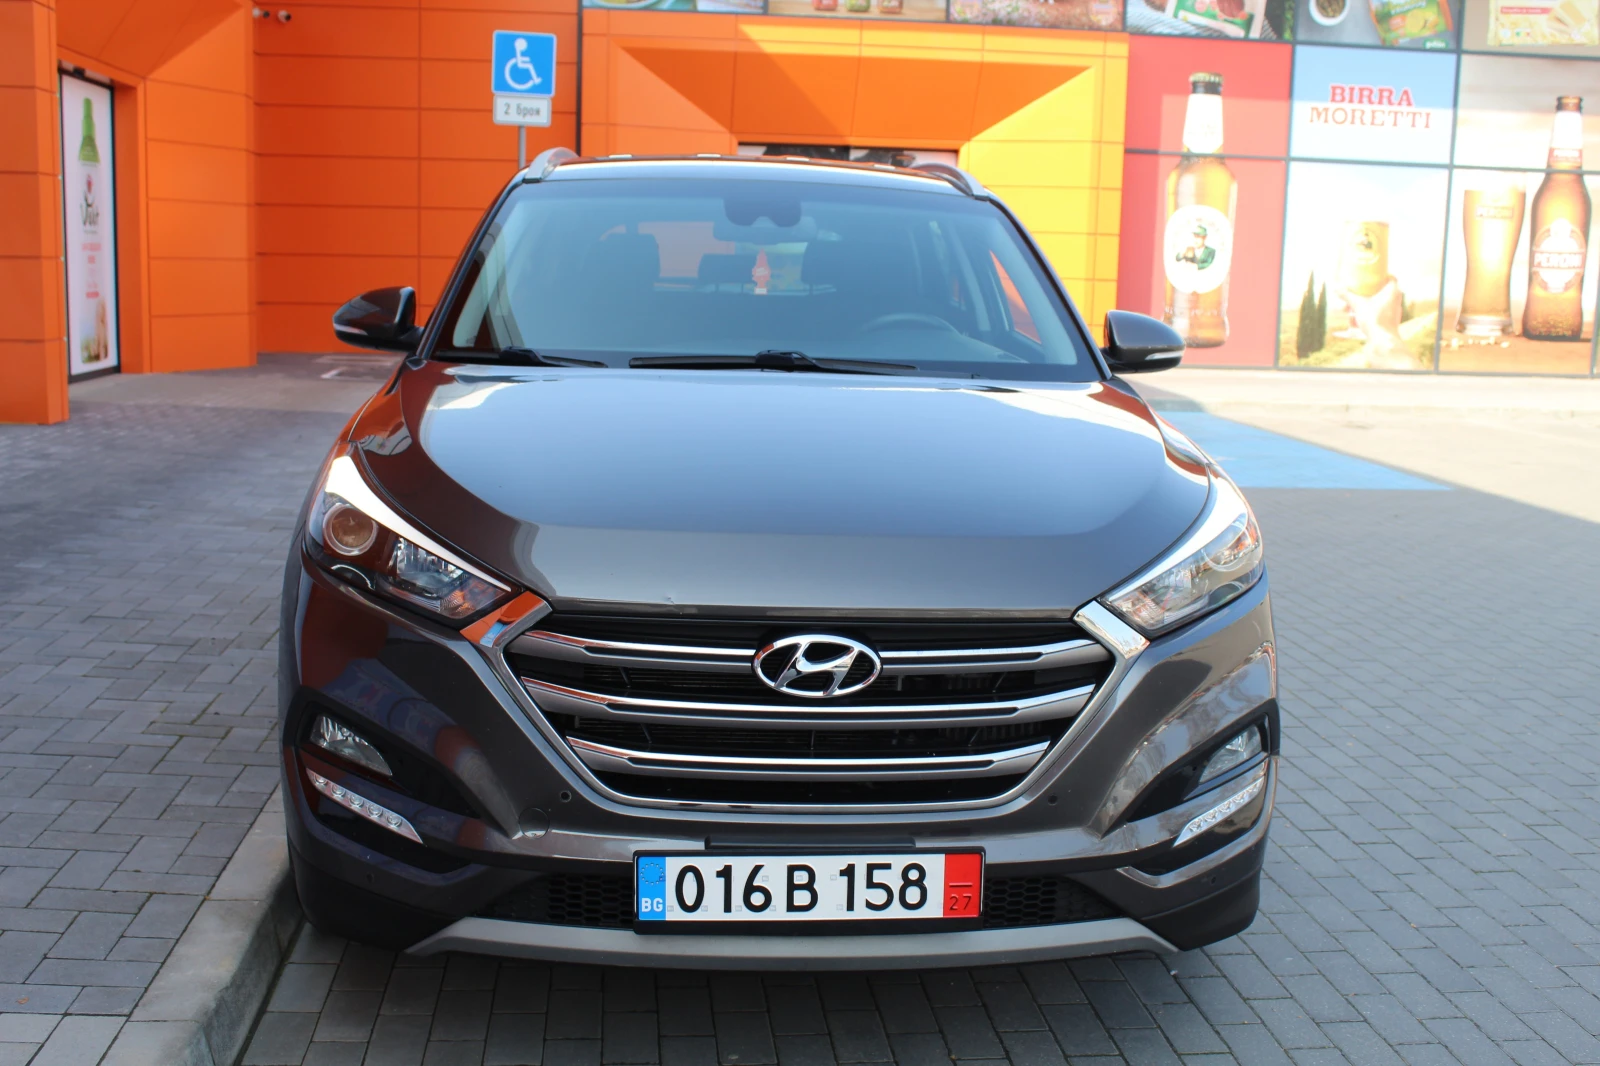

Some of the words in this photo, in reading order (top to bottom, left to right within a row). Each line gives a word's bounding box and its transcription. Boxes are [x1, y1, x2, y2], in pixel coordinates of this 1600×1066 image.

[1330, 84, 1414, 107] BIRRA
[504, 102, 511, 115] 2
[516, 103, 541, 119] броя
[1309, 106, 1431, 129] MORETTI
[641, 897, 664, 912] BG
[675, 864, 773, 913] 016
[786, 864, 819, 912] B
[839, 862, 928, 911] 158
[949, 893, 972, 911] 27
